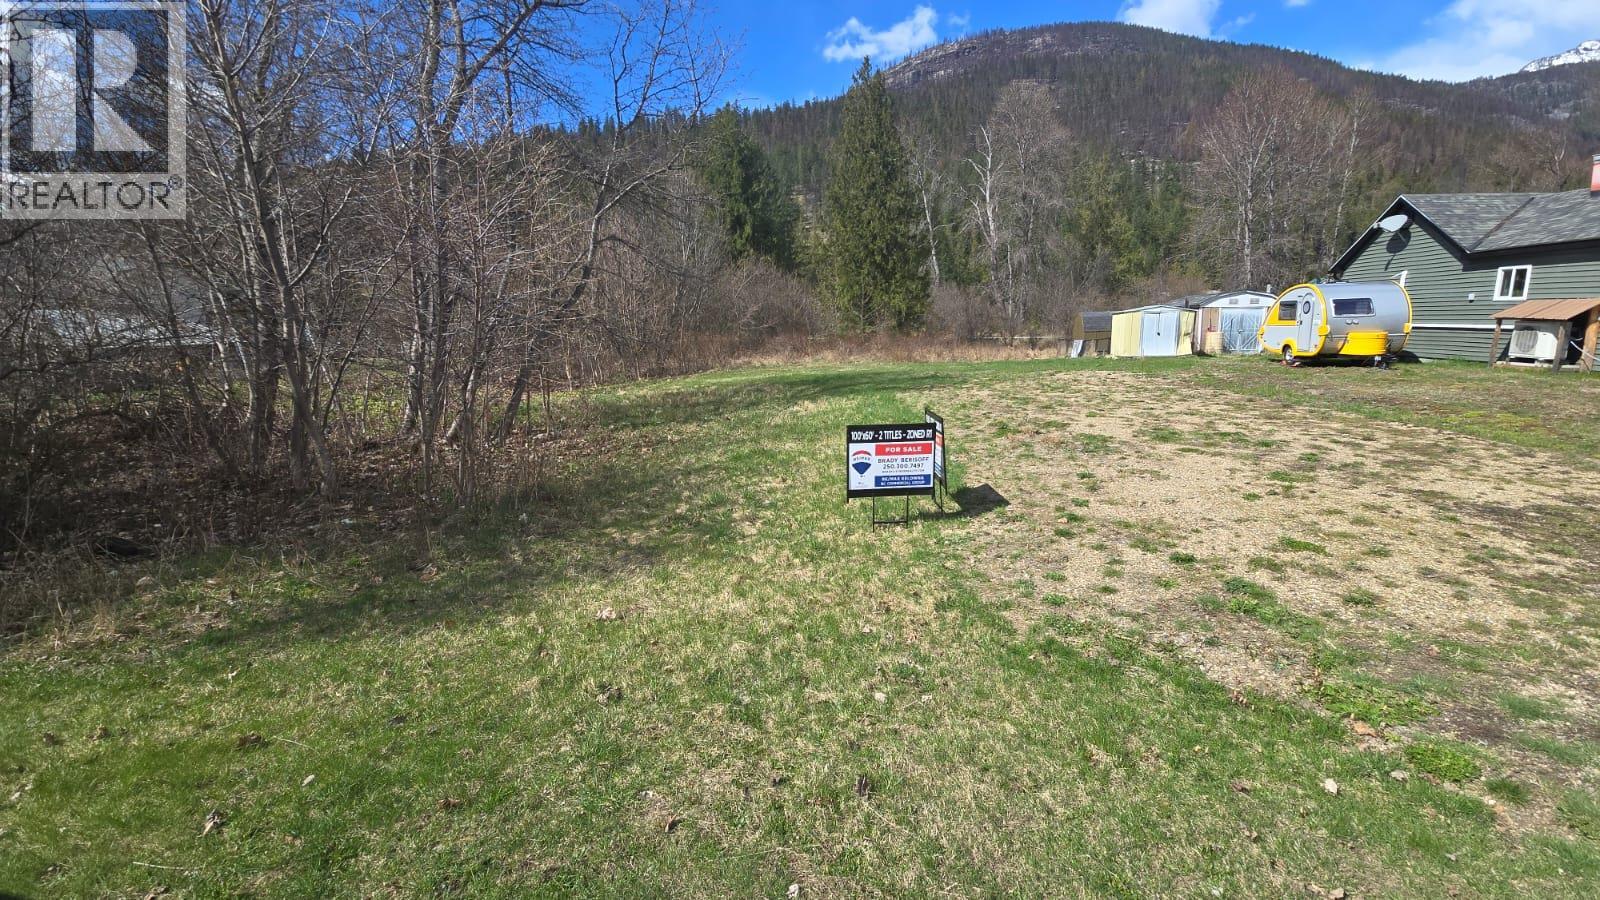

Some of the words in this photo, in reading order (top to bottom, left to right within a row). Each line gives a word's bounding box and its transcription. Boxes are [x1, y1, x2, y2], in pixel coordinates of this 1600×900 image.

[879, 430, 883, 440] 2
[884, 430, 902, 440] TITLES
[906, 429, 925, 439] ZONED
